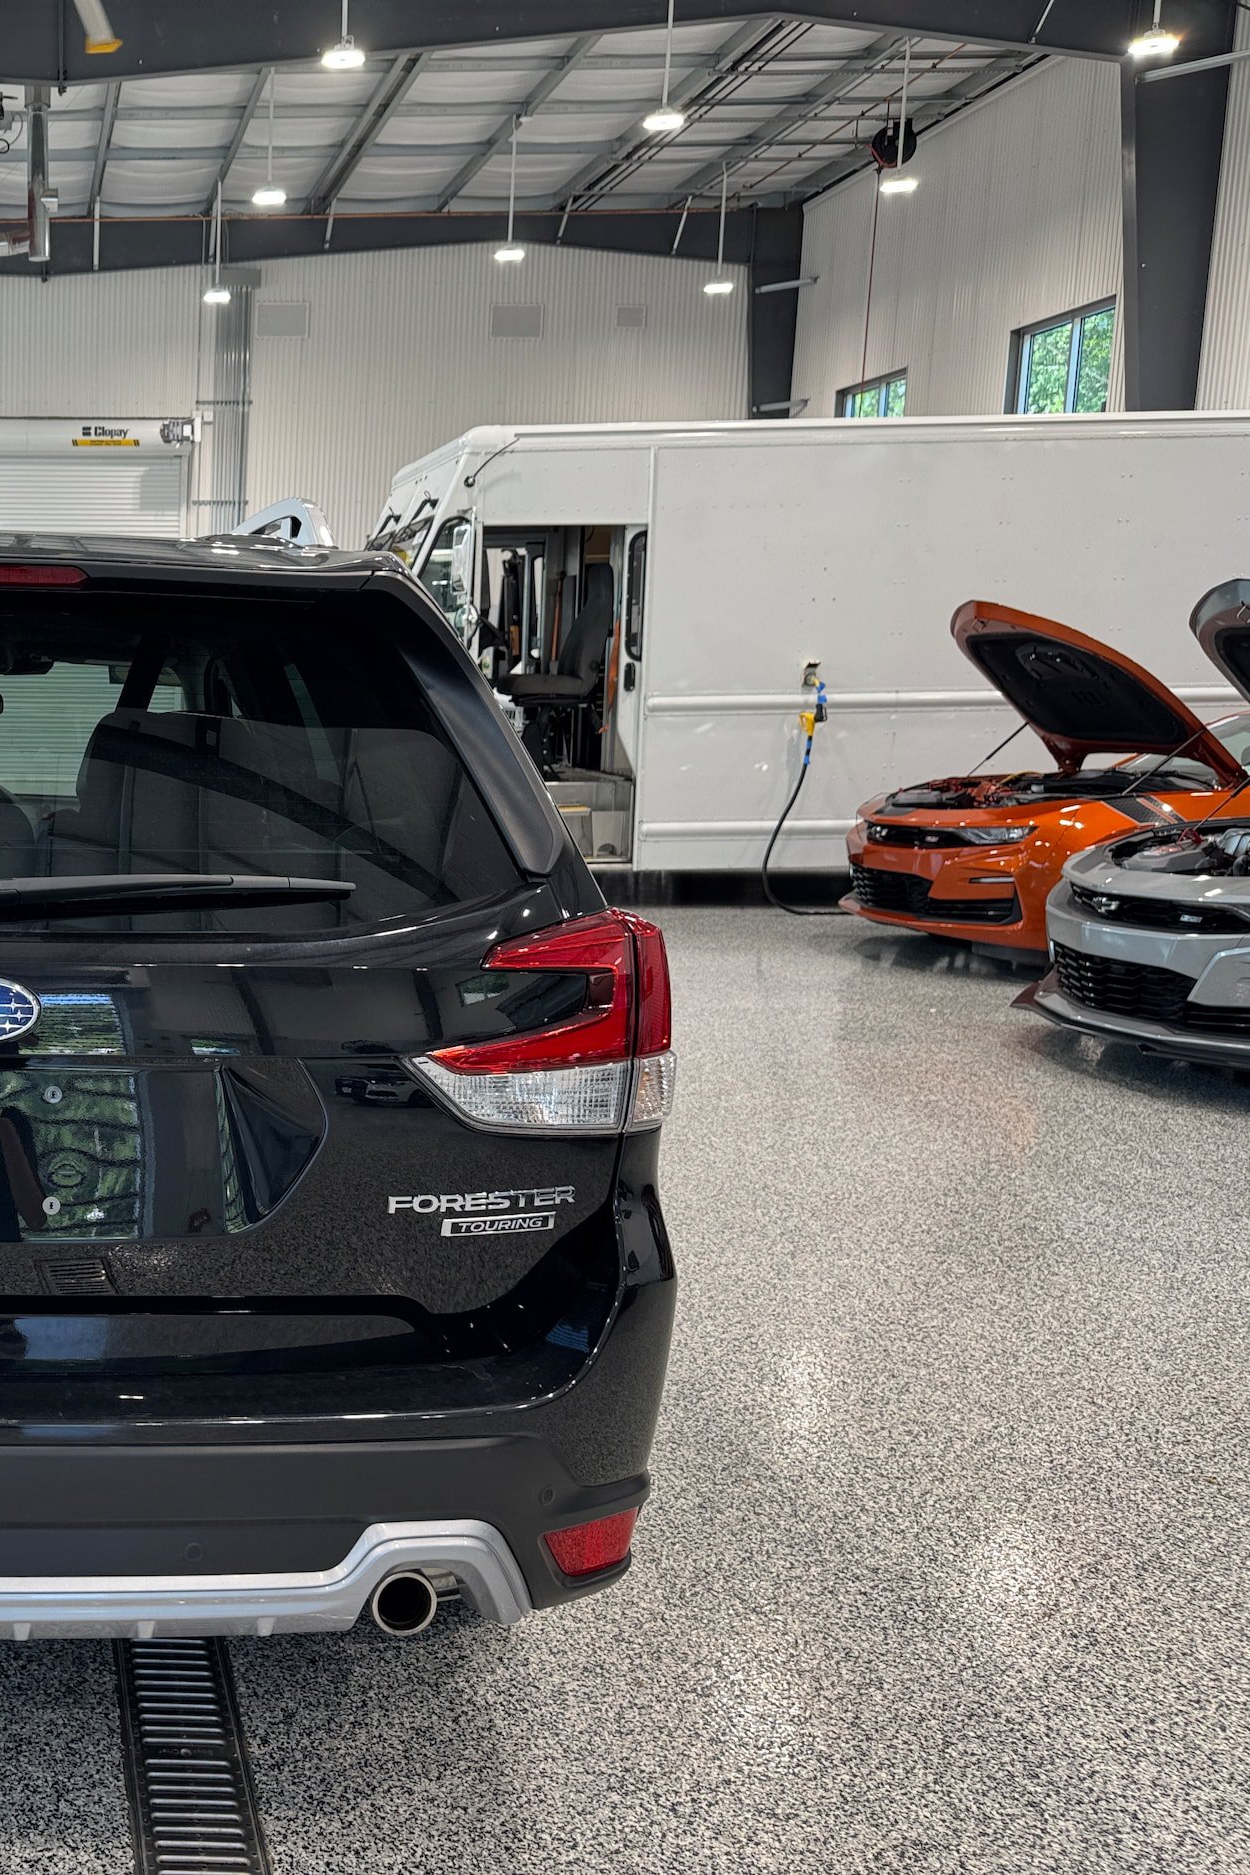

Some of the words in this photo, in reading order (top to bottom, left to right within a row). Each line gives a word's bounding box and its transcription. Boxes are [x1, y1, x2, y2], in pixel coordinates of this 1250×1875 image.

[94, 426, 128, 439] Clopay
[387, 1186, 576, 1214] FORESTER
[458, 1217, 543, 1232] TOURING
